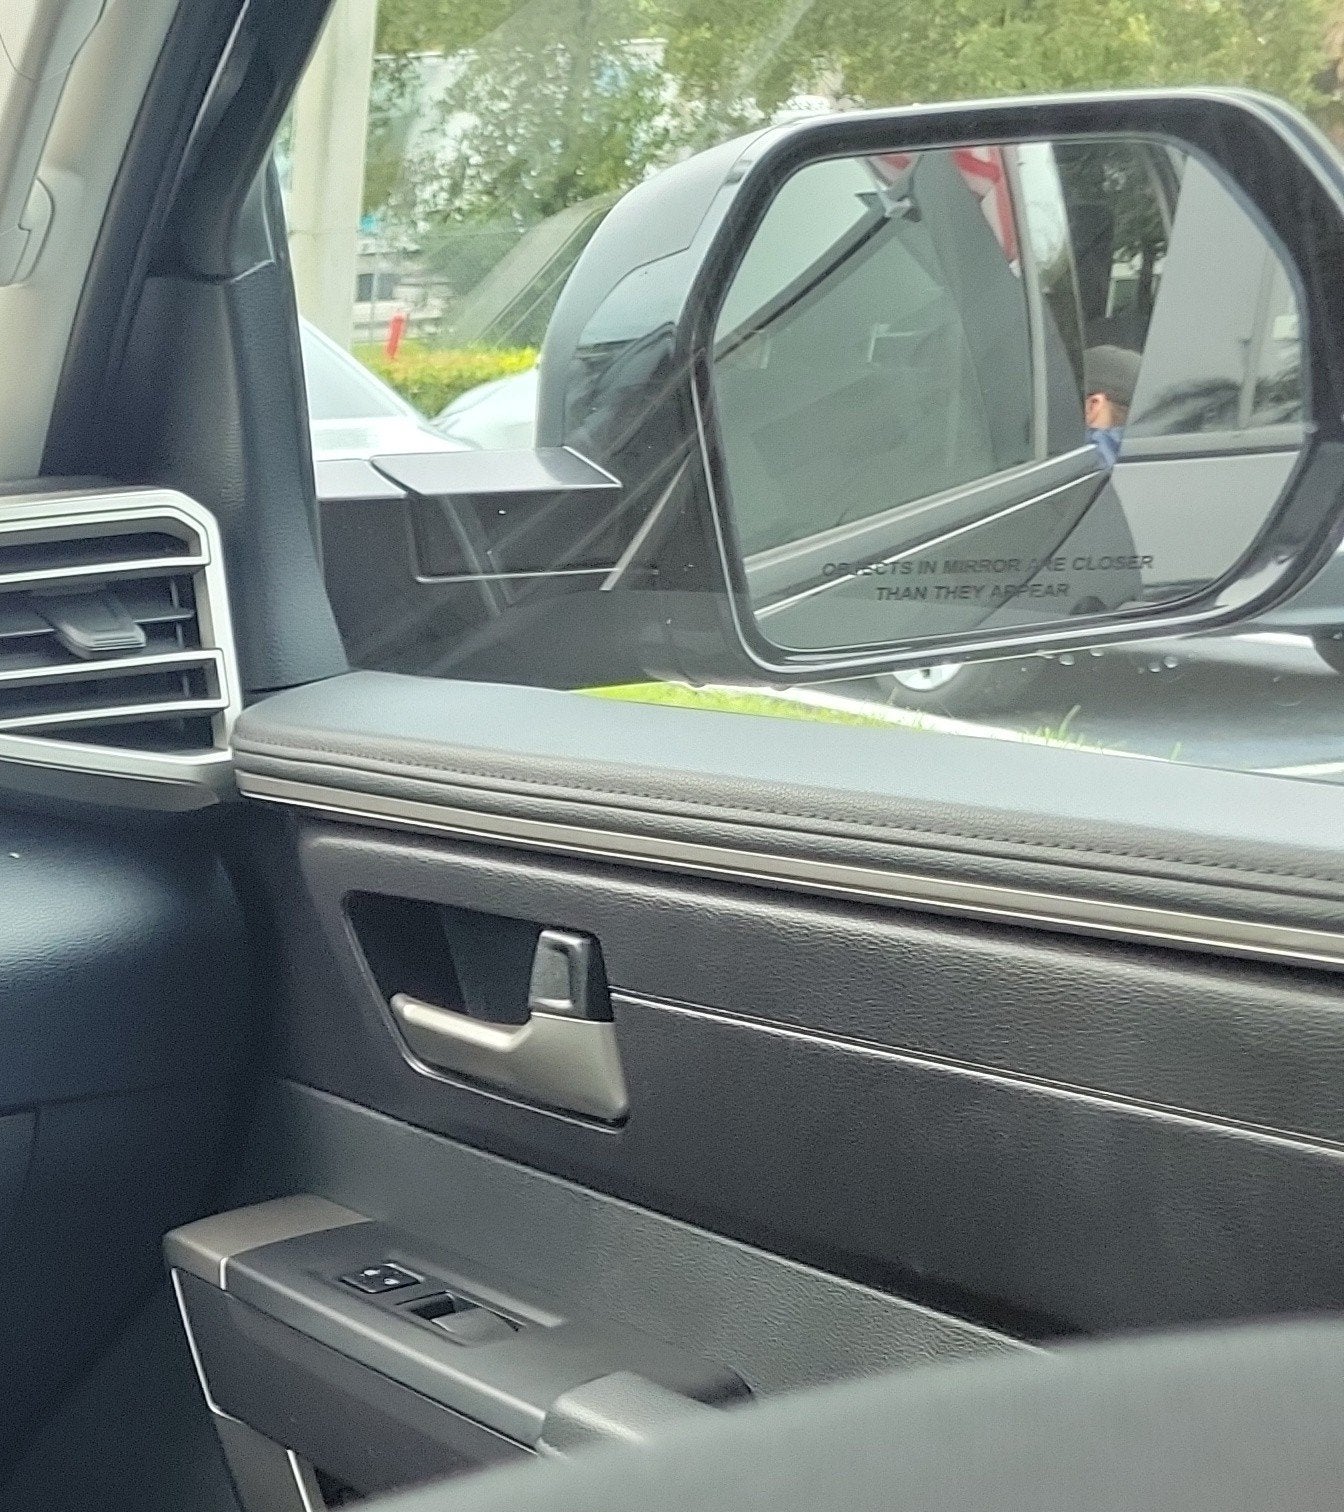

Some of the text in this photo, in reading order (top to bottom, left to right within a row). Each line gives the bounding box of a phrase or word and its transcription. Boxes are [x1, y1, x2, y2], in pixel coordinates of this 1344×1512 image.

[822, 561, 913, 577] OBECTS
[918, 560, 936, 574] IN
[943, 558, 1021, 574] MIRROR
[1072, 555, 1154, 571] CLOSER
[876, 583, 1070, 601] THAN THEY APPEAR
